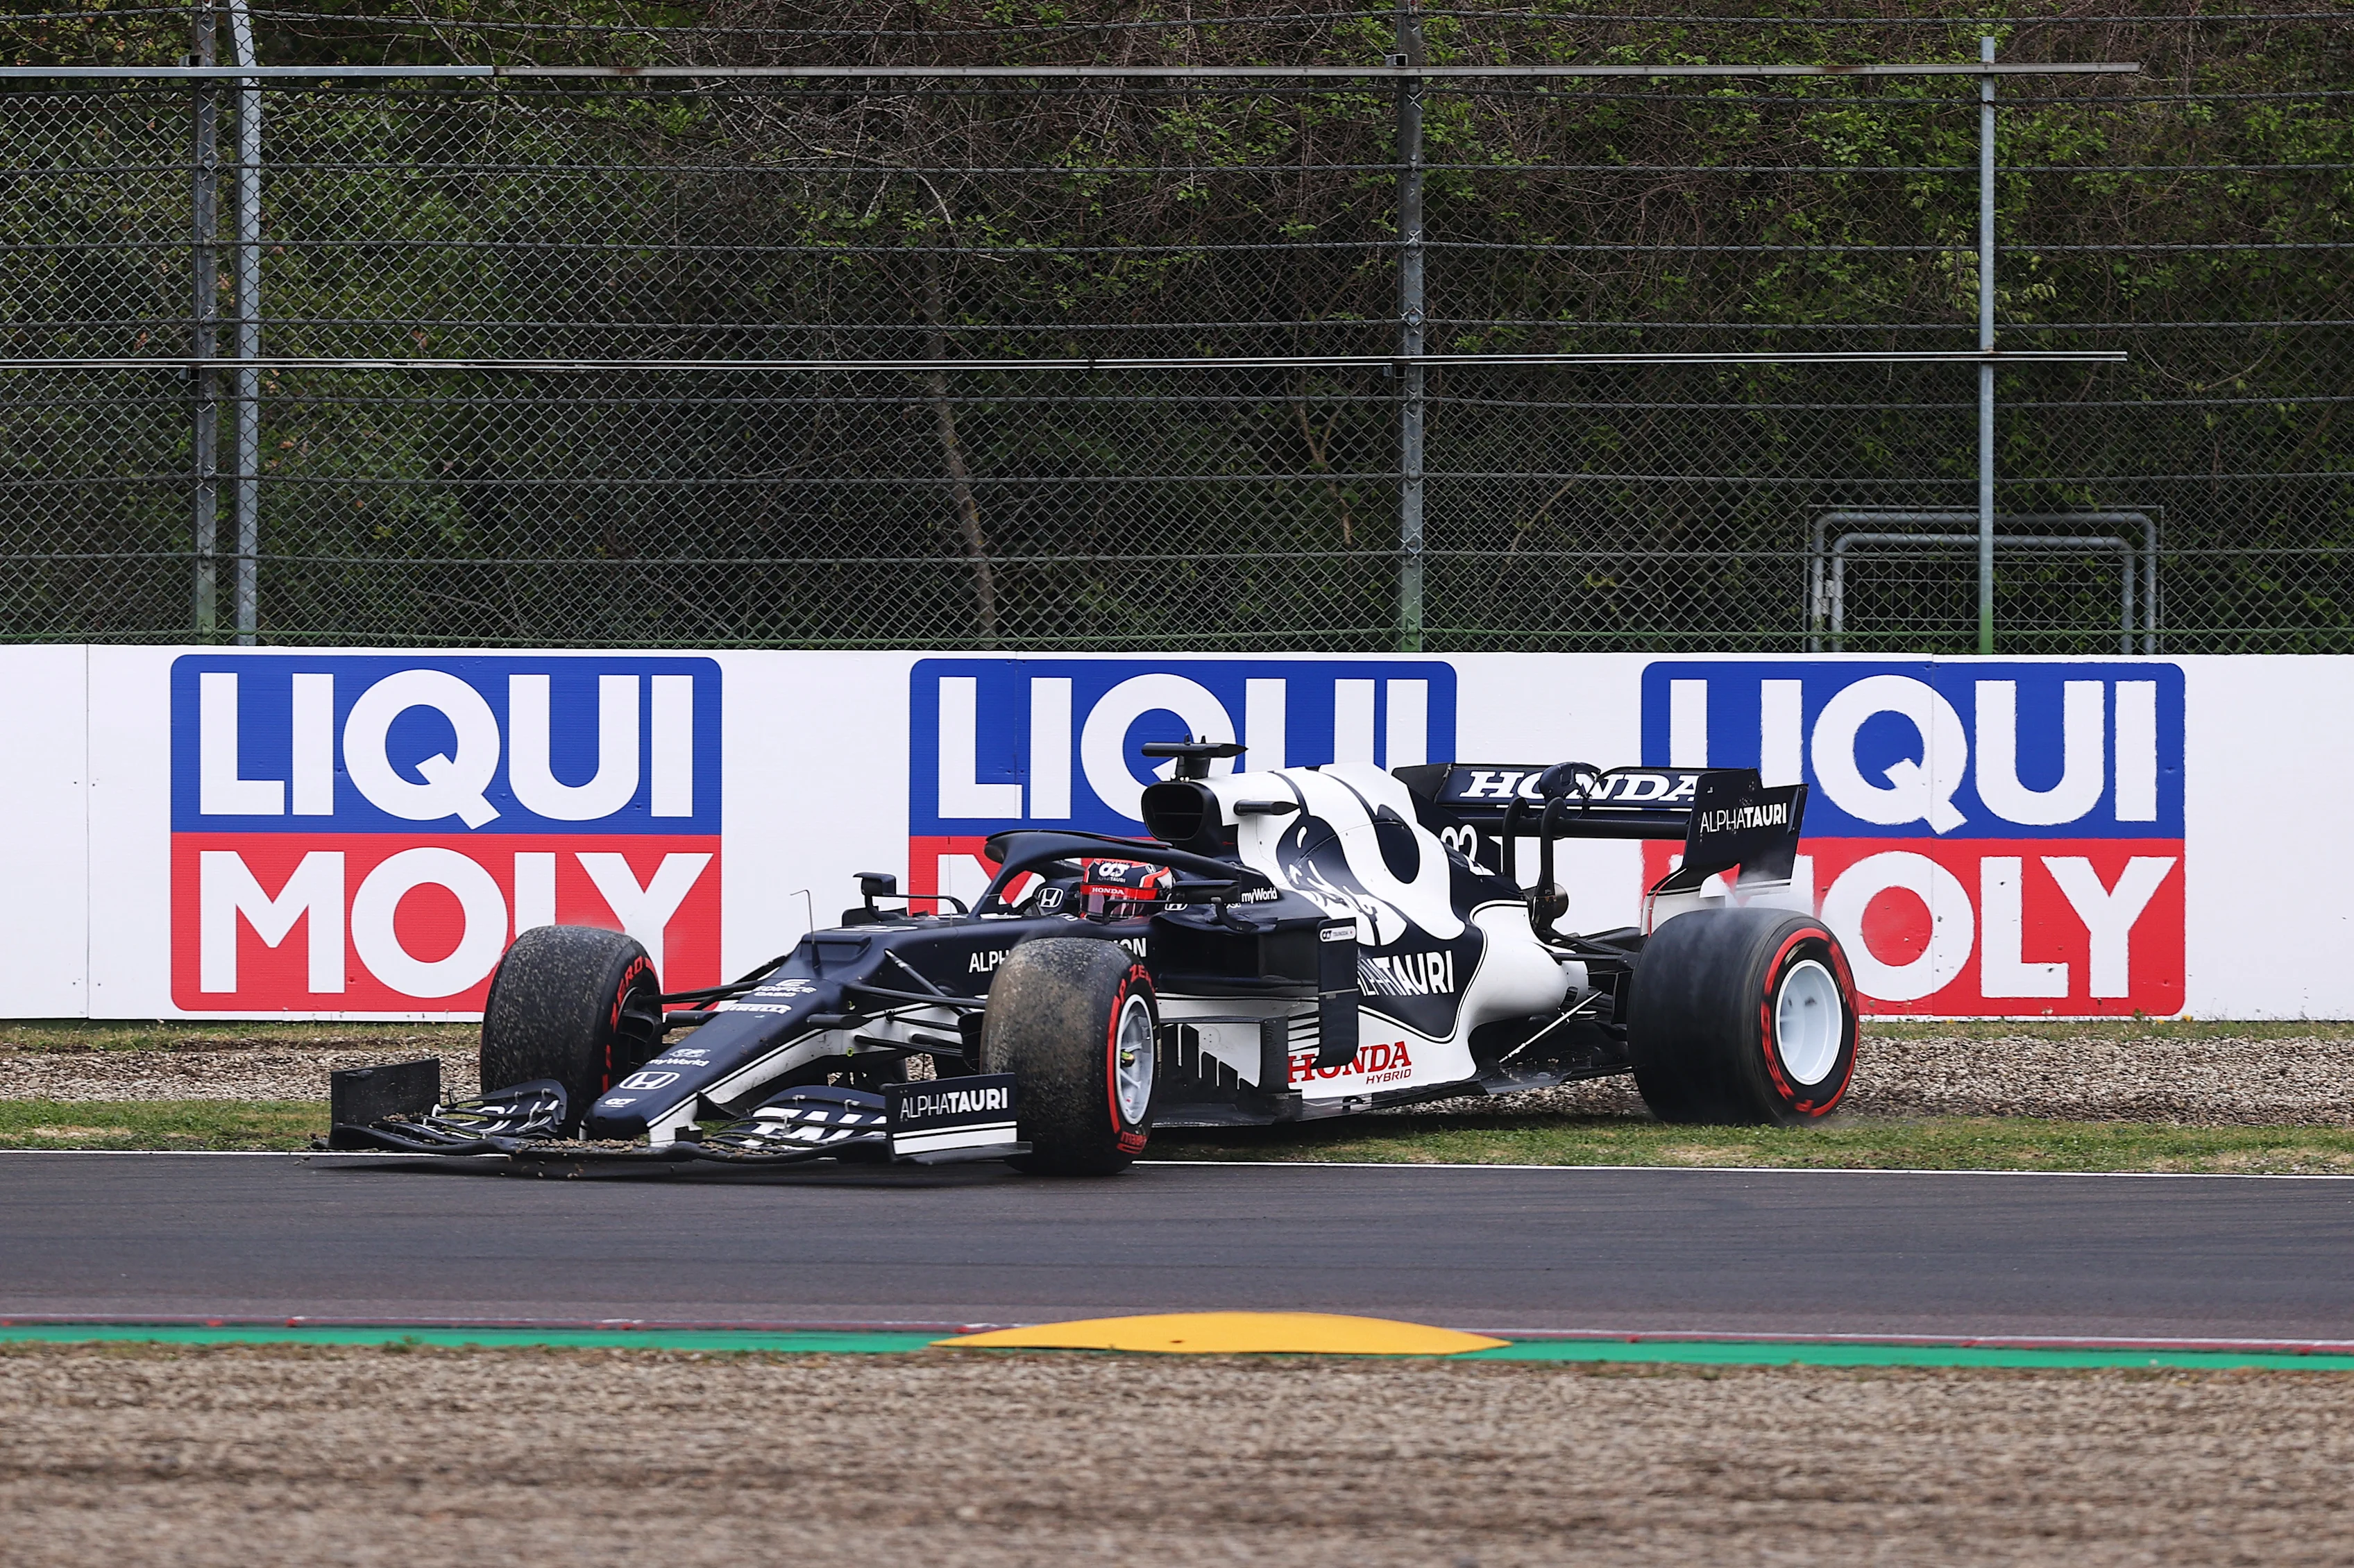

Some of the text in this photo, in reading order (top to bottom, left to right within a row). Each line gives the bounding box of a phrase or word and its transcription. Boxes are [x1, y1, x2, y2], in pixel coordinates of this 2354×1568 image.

[199, 669, 694, 830] LIQUI
[1700, 802, 1787, 833] ALPHATAURI
[1092, 887, 1125, 895] HONDA
[1242, 887, 1278, 904] myWorld
[753, 985, 817, 994] EDIFICE
[1366, 1068, 1412, 1085] HYBRID
[899, 1086, 1008, 1119] ALPHATAURI
